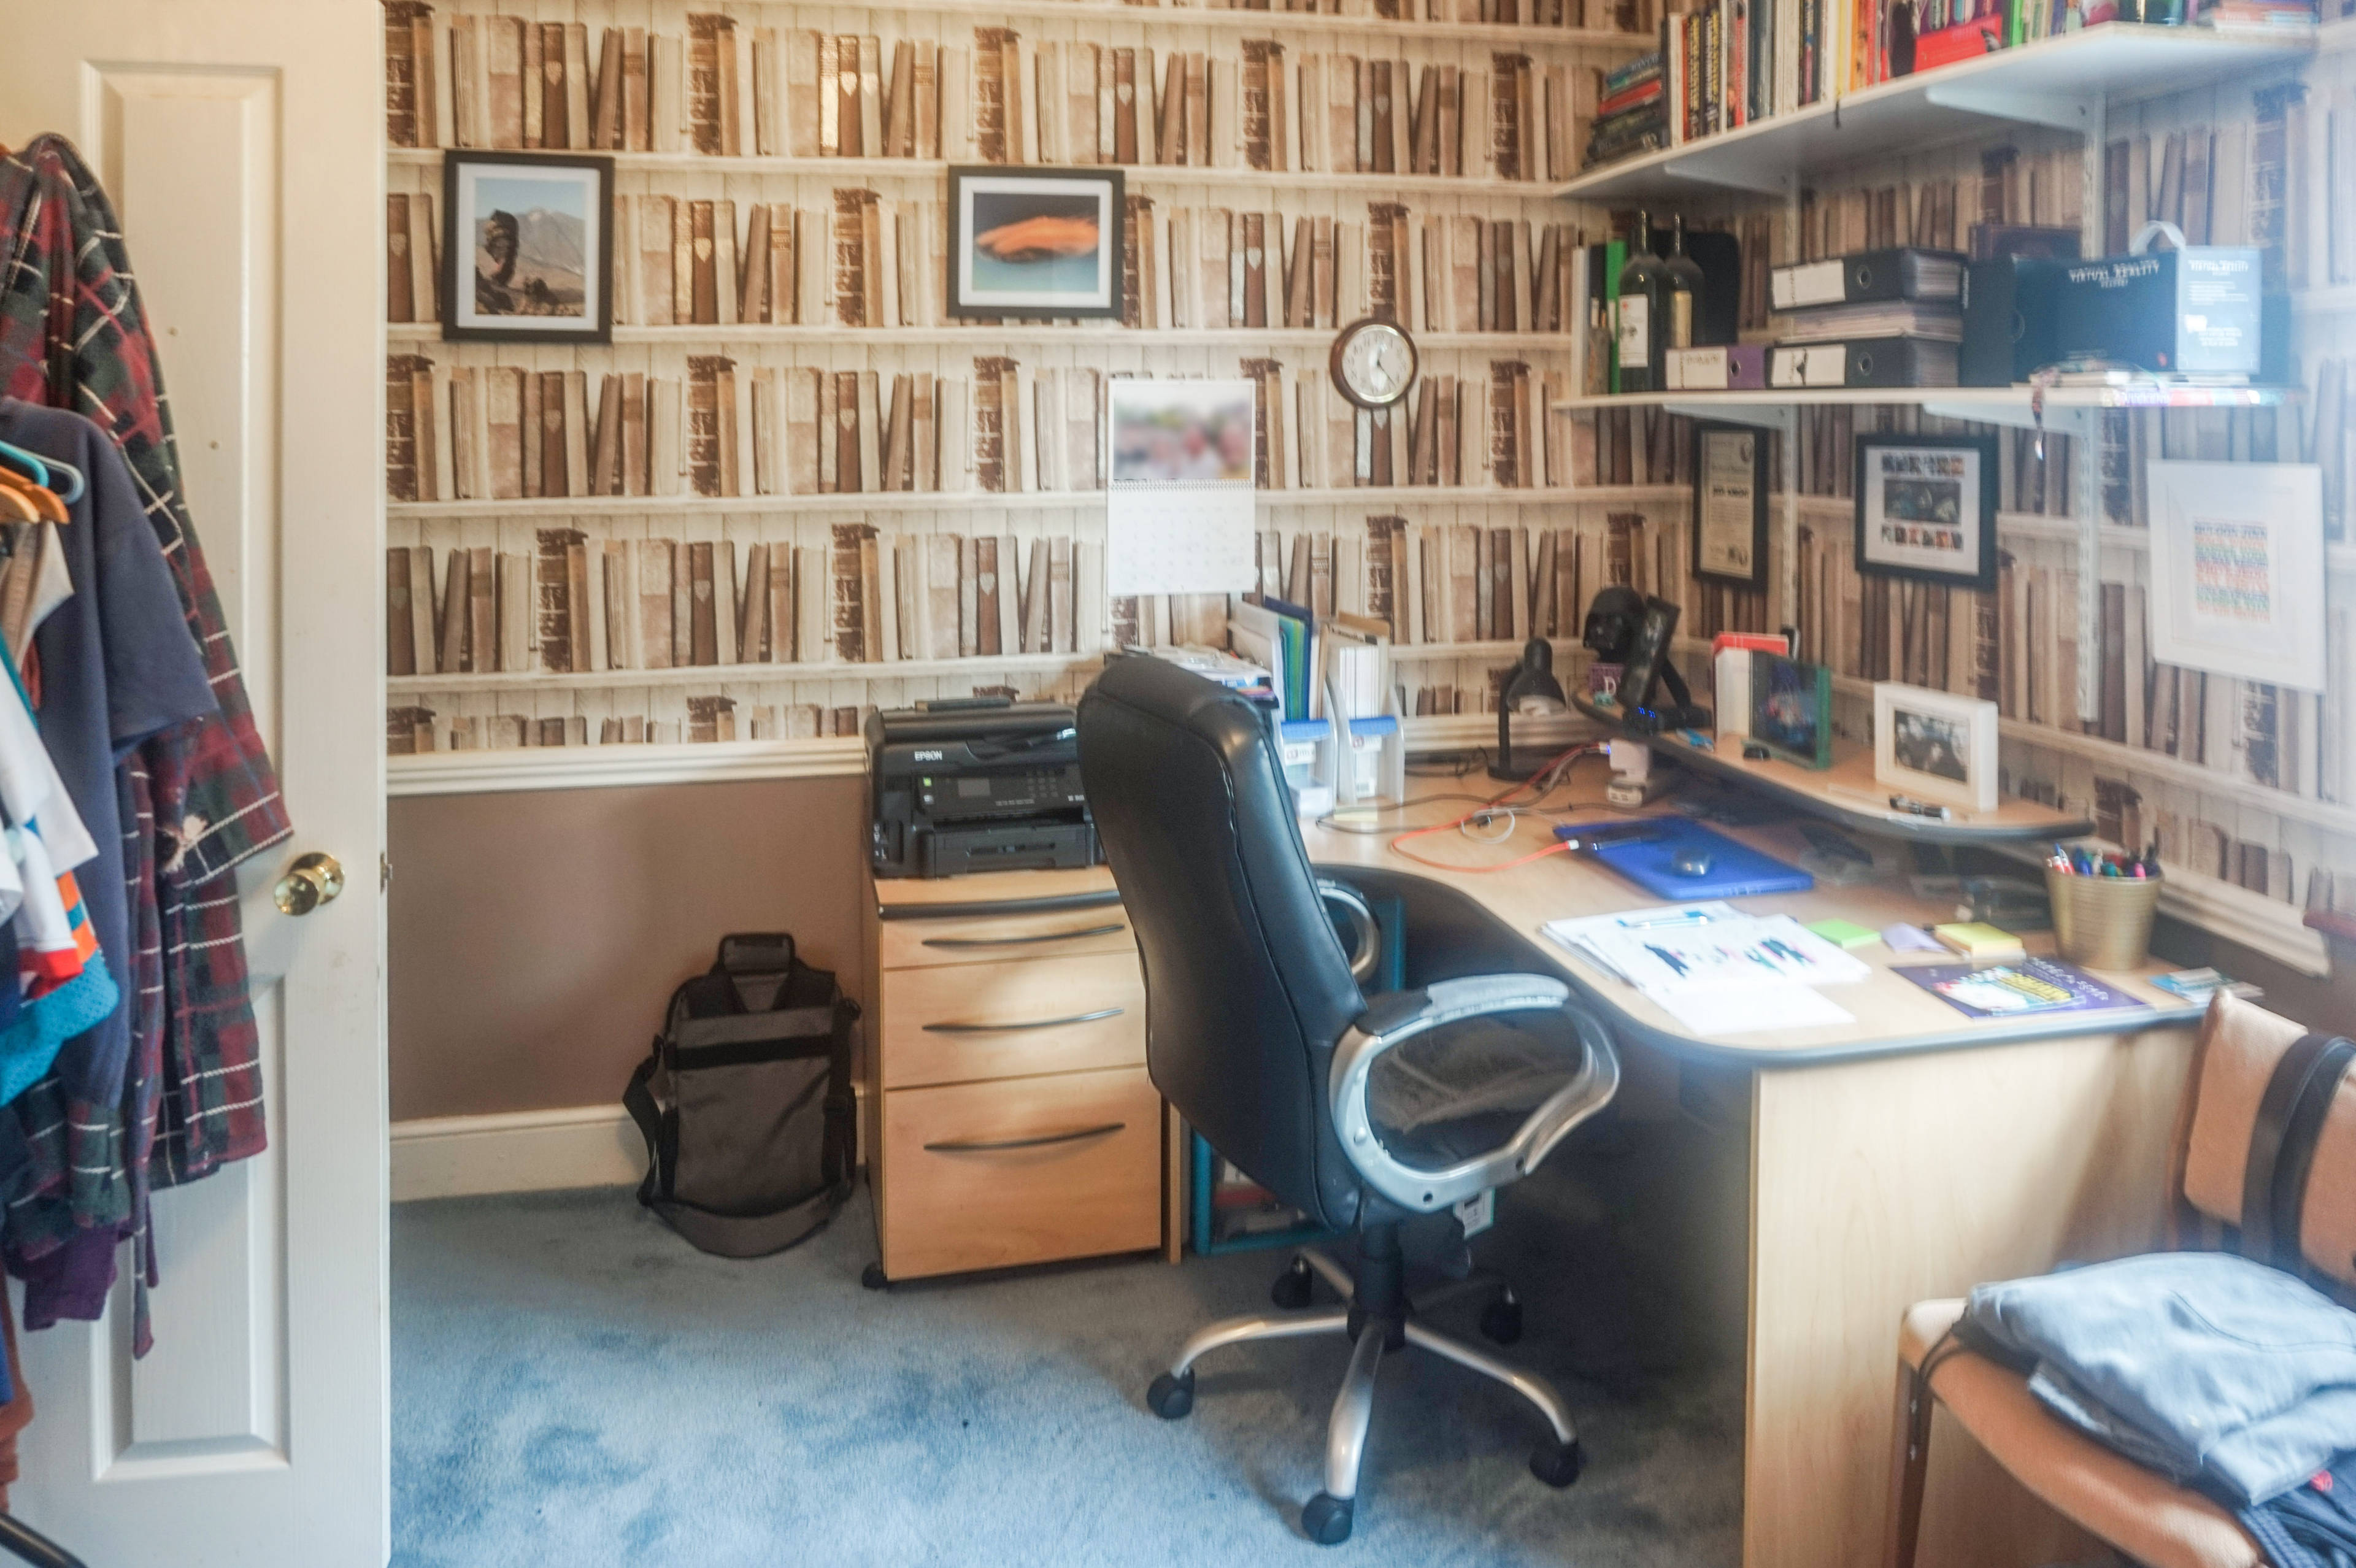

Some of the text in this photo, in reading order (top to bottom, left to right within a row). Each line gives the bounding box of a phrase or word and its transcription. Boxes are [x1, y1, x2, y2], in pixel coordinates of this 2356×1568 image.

[2068, 259, 2160, 283] VIRTUAL REALITY
[914, 750, 942, 761] EPSON
